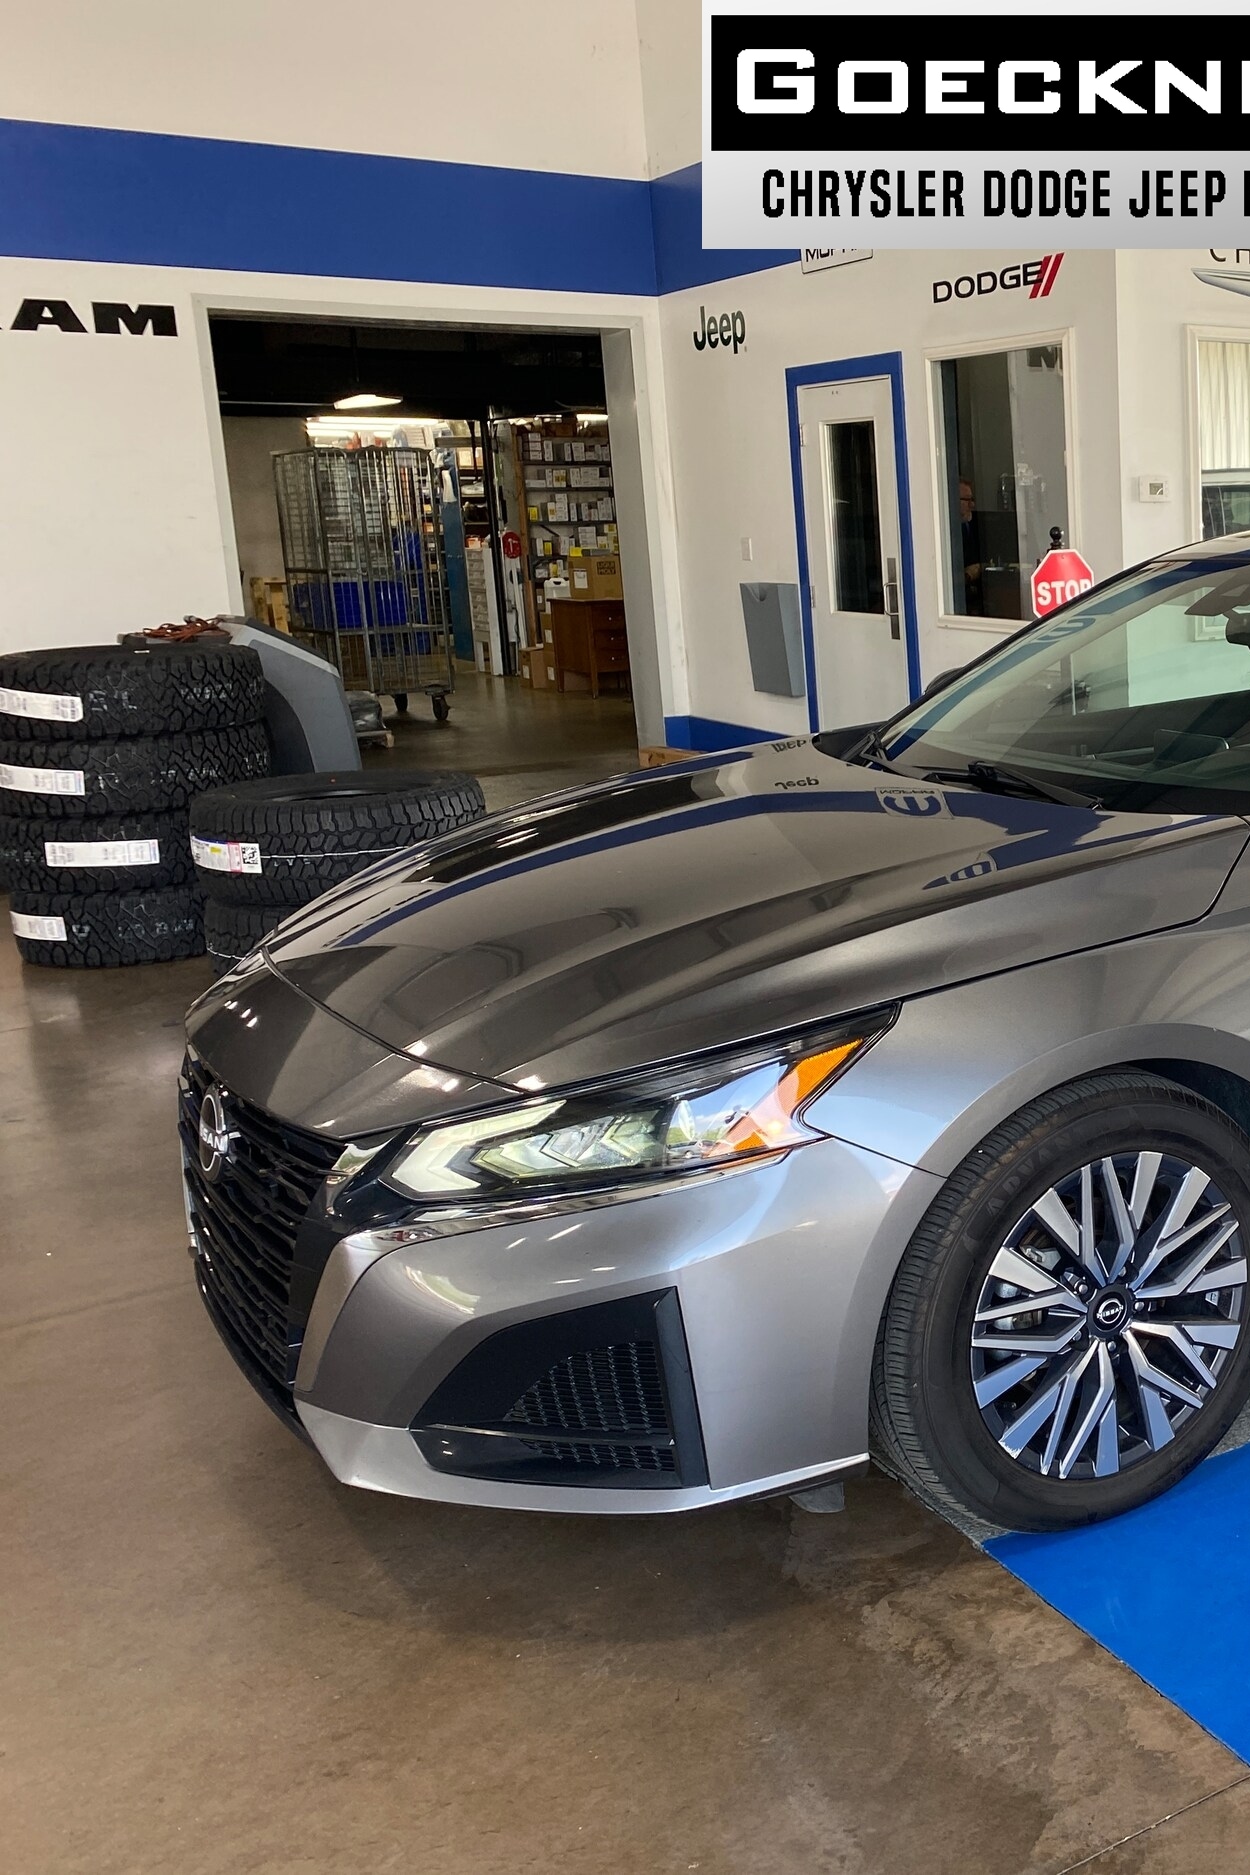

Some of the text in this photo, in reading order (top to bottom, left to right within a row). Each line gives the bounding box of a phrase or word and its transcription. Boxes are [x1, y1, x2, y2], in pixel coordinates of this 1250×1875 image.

[932, 260, 1044, 304] DODGE
[0, 298, 178, 337] AM
[693, 305, 746, 355] Jeep
[1037, 578, 1092, 605] STOP
